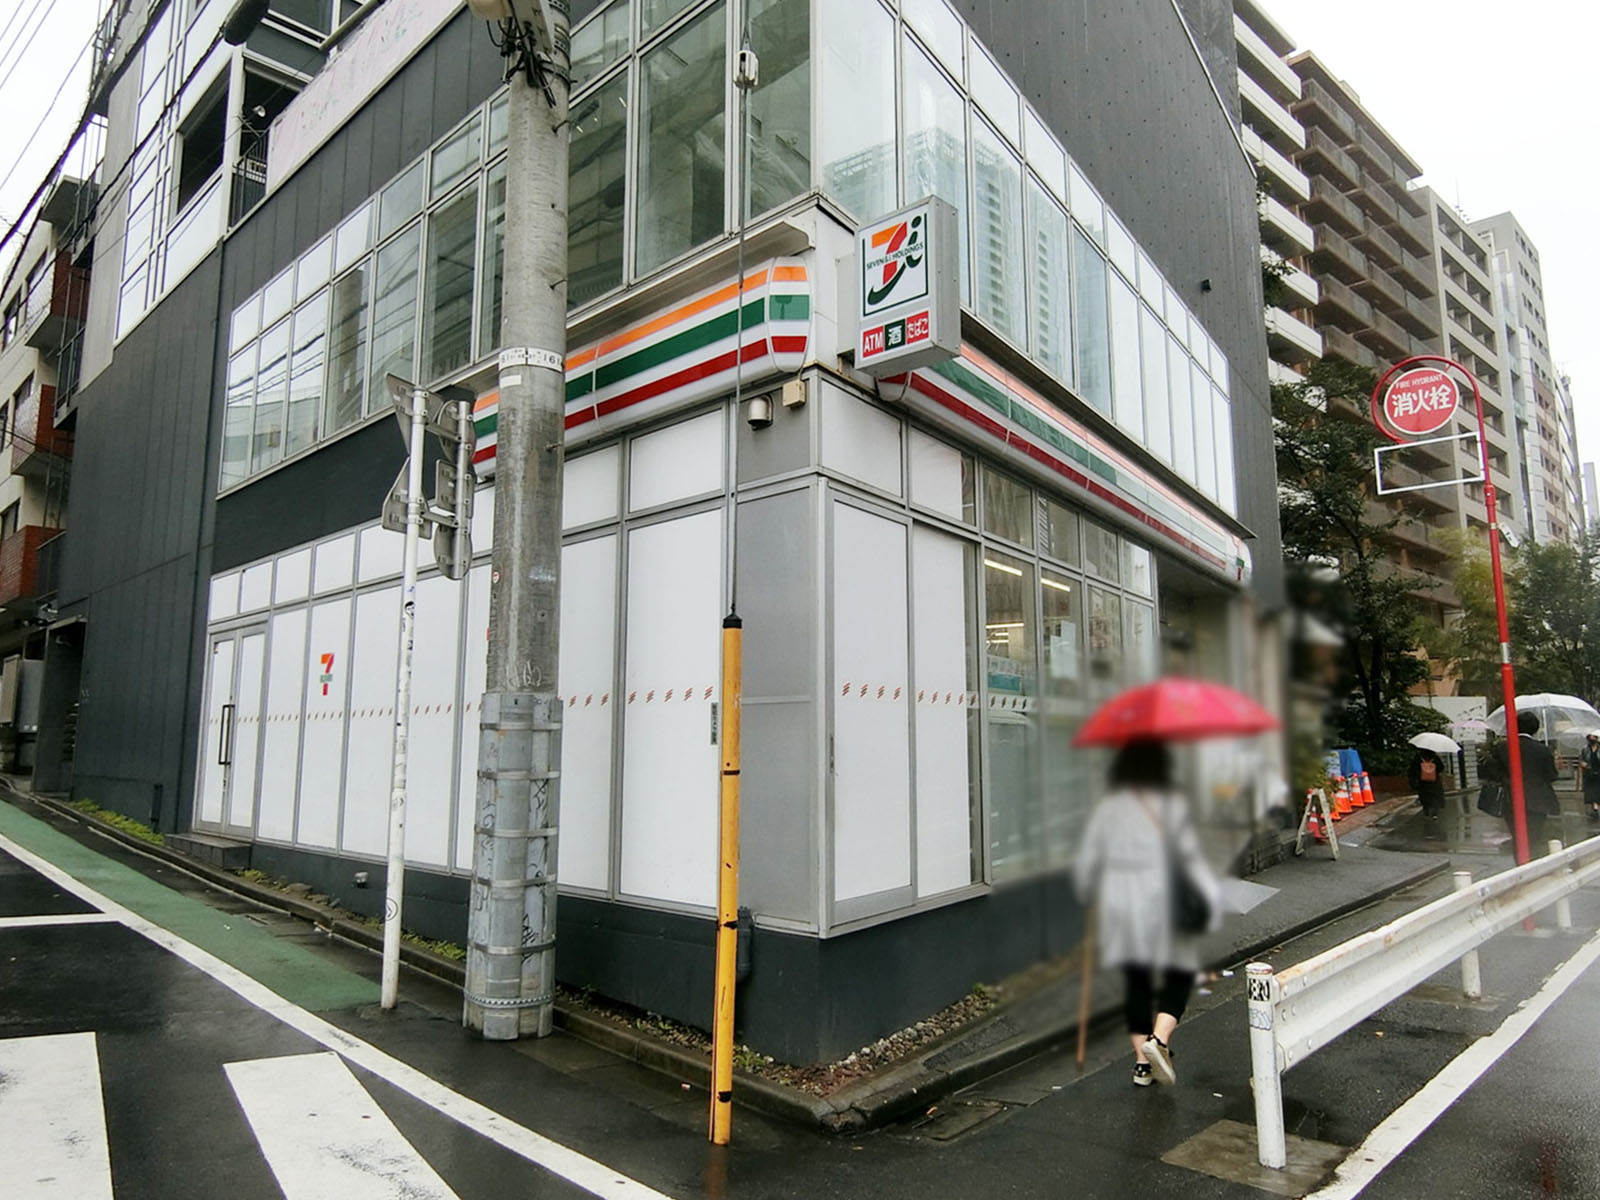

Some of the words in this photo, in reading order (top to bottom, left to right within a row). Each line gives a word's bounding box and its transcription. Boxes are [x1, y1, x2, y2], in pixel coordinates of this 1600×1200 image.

[864, 331, 884, 353] ATM
[888, 325, 902, 346] 酒
[907, 318, 929, 339] たばこ
[1395, 379, 1411, 389] FIRE
[1412, 374, 1443, 386] HYDRANT
[1391, 384, 1452, 418] 消火栓
